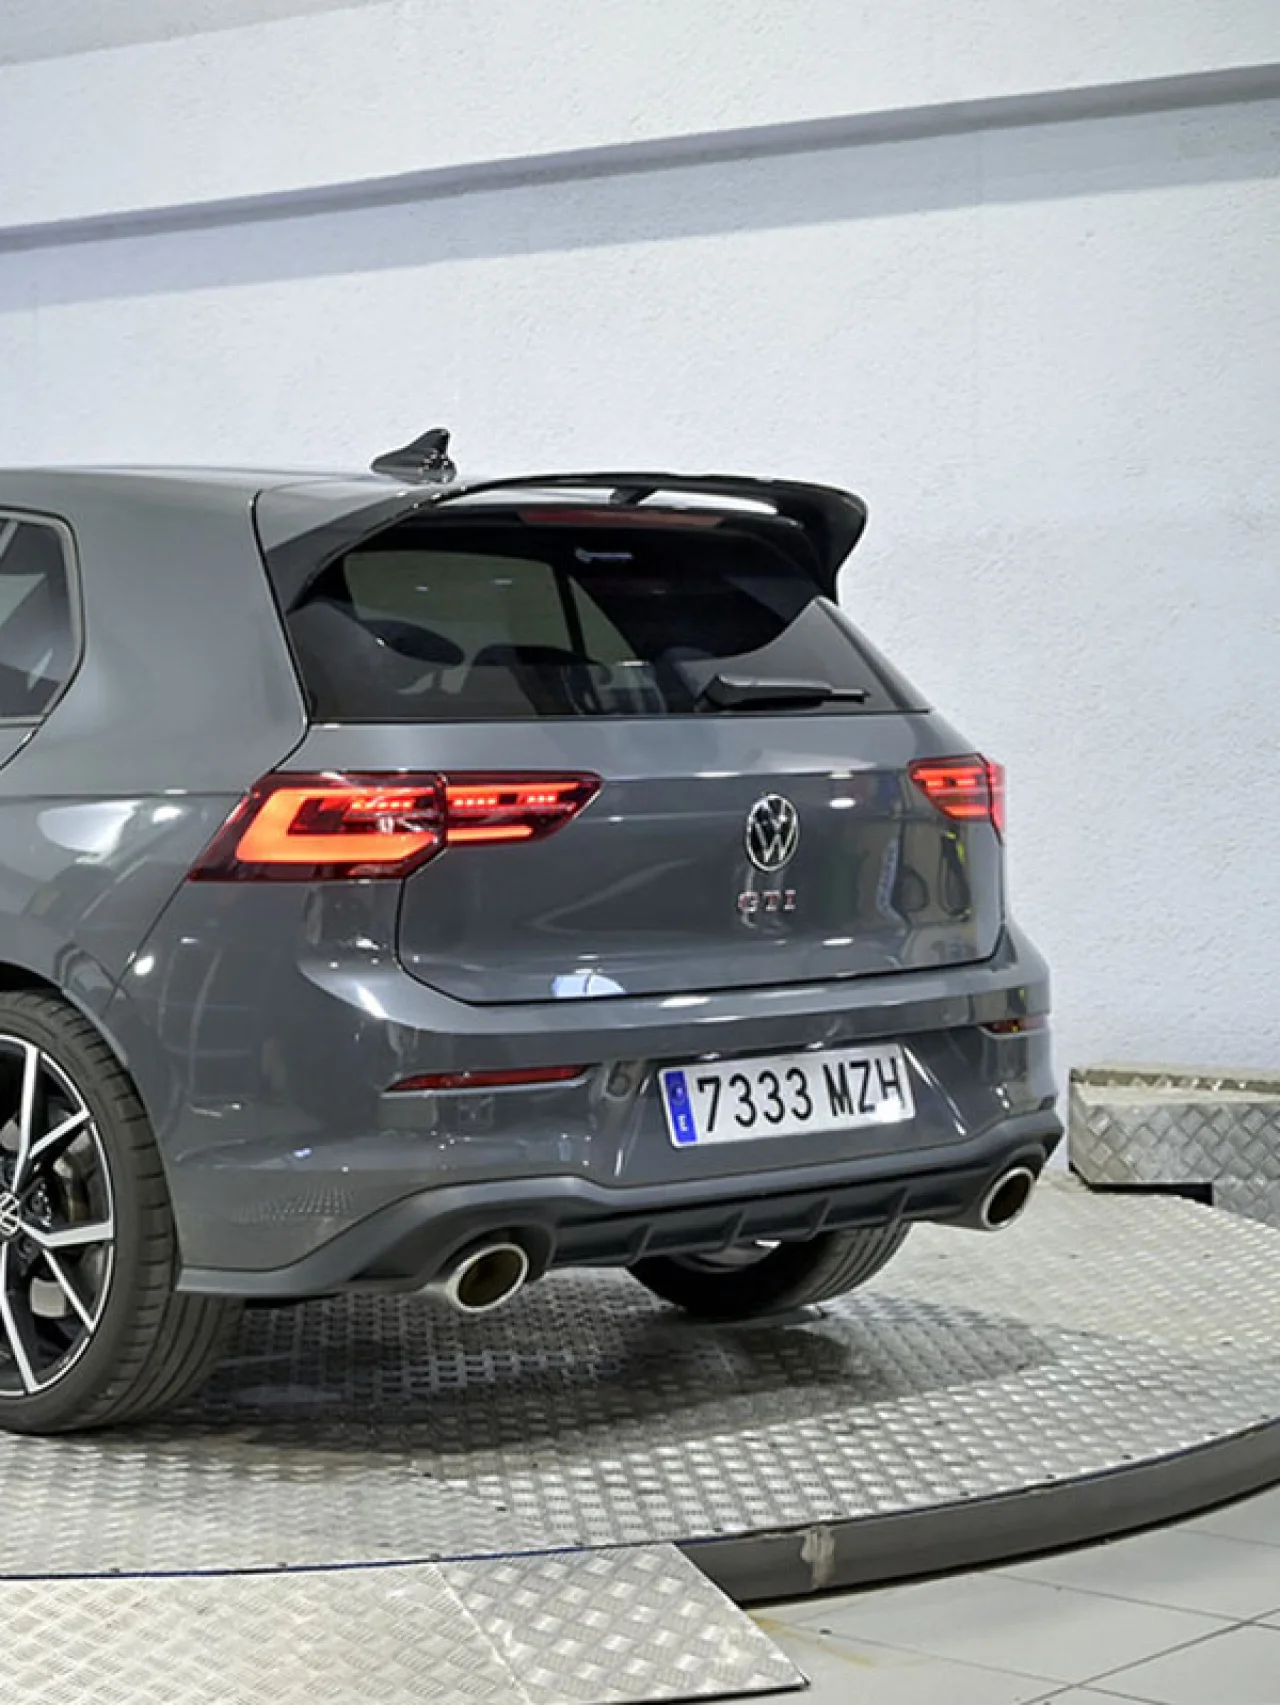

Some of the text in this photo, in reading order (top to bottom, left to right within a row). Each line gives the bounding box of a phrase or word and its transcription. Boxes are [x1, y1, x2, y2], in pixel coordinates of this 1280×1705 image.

[738, 889, 796, 912] GTI
[697, 1056, 906, 1132] 7333 MZH
